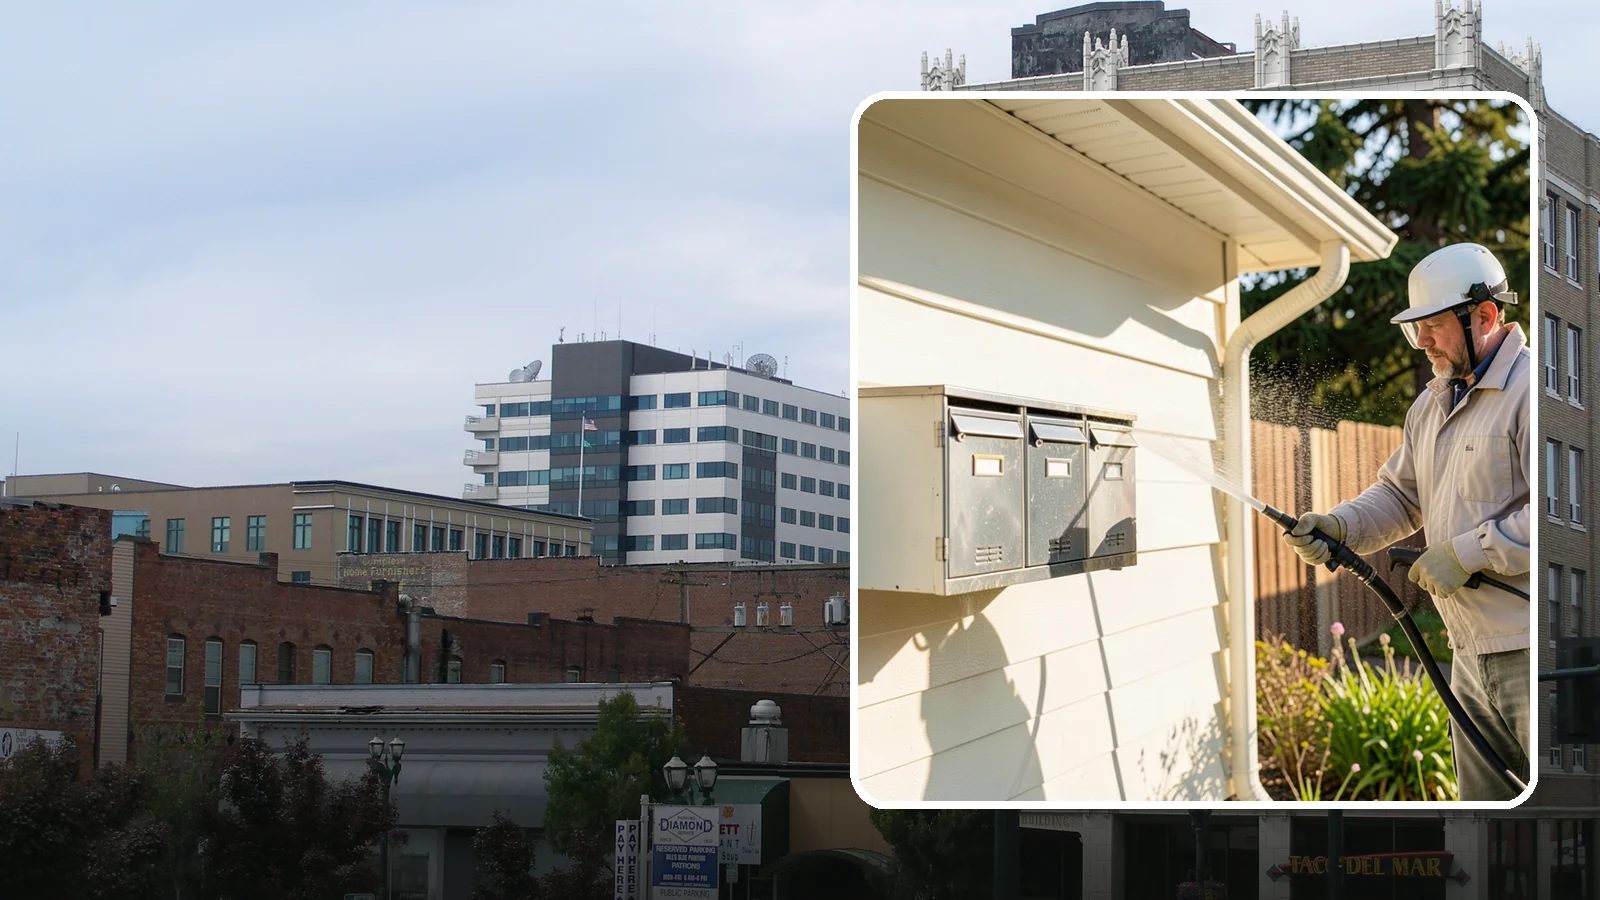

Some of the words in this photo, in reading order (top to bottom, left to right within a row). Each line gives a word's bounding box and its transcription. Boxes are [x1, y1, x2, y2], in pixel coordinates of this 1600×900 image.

[343, 567, 368, 577] Home
[370, 566, 427, 577] Furnishers
[660, 818, 713, 833] DIAMOND
[1021, 815, 1070, 828] BUILDING
[617, 824, 625, 853] PAY
[628, 824, 637, 853] PAY
[656, 845, 688, 853] RESERVED
[690, 846, 716, 854] PARKING
[721, 851, 739, 863] Soup
[671, 862, 701, 870] PATRONS
[1346, 856, 1385, 876] DEL
[1392, 857, 1442, 877] MAR
[616, 855, 625, 894] HERE
[627, 855, 637, 894] HERE
[660, 888, 682, 897] PUBLIC
[684, 889, 710, 898] PARKING
